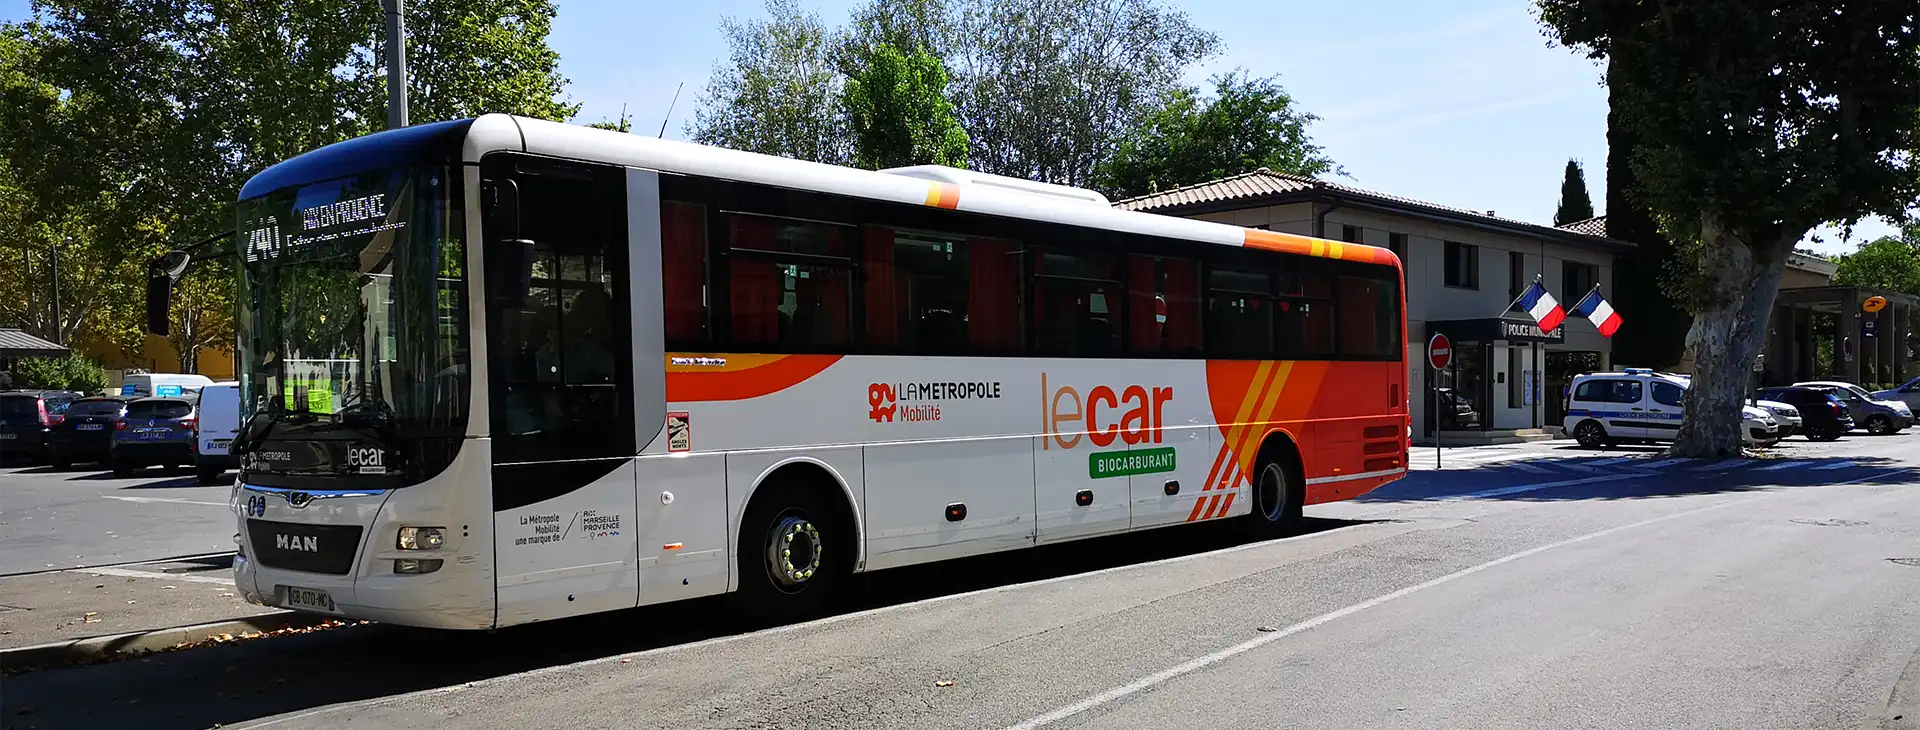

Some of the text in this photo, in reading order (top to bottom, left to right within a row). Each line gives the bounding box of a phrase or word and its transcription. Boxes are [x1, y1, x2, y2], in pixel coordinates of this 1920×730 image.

[303, 194, 386, 230] AIX EN PROVENCE
[245, 216, 281, 262] 240
[1508, 324, 1528, 336] POLICE
[900, 404, 941, 422] Mobilité
[1098, 453, 1175, 473] BIOCARBURANT
[520, 513, 560, 525] La Métropole
[583, 522, 620, 531] PROVENCE
[535, 524, 560, 535] Mobilité
[276, 534, 317, 552] MAN
[515, 533, 560, 546] une marque de
